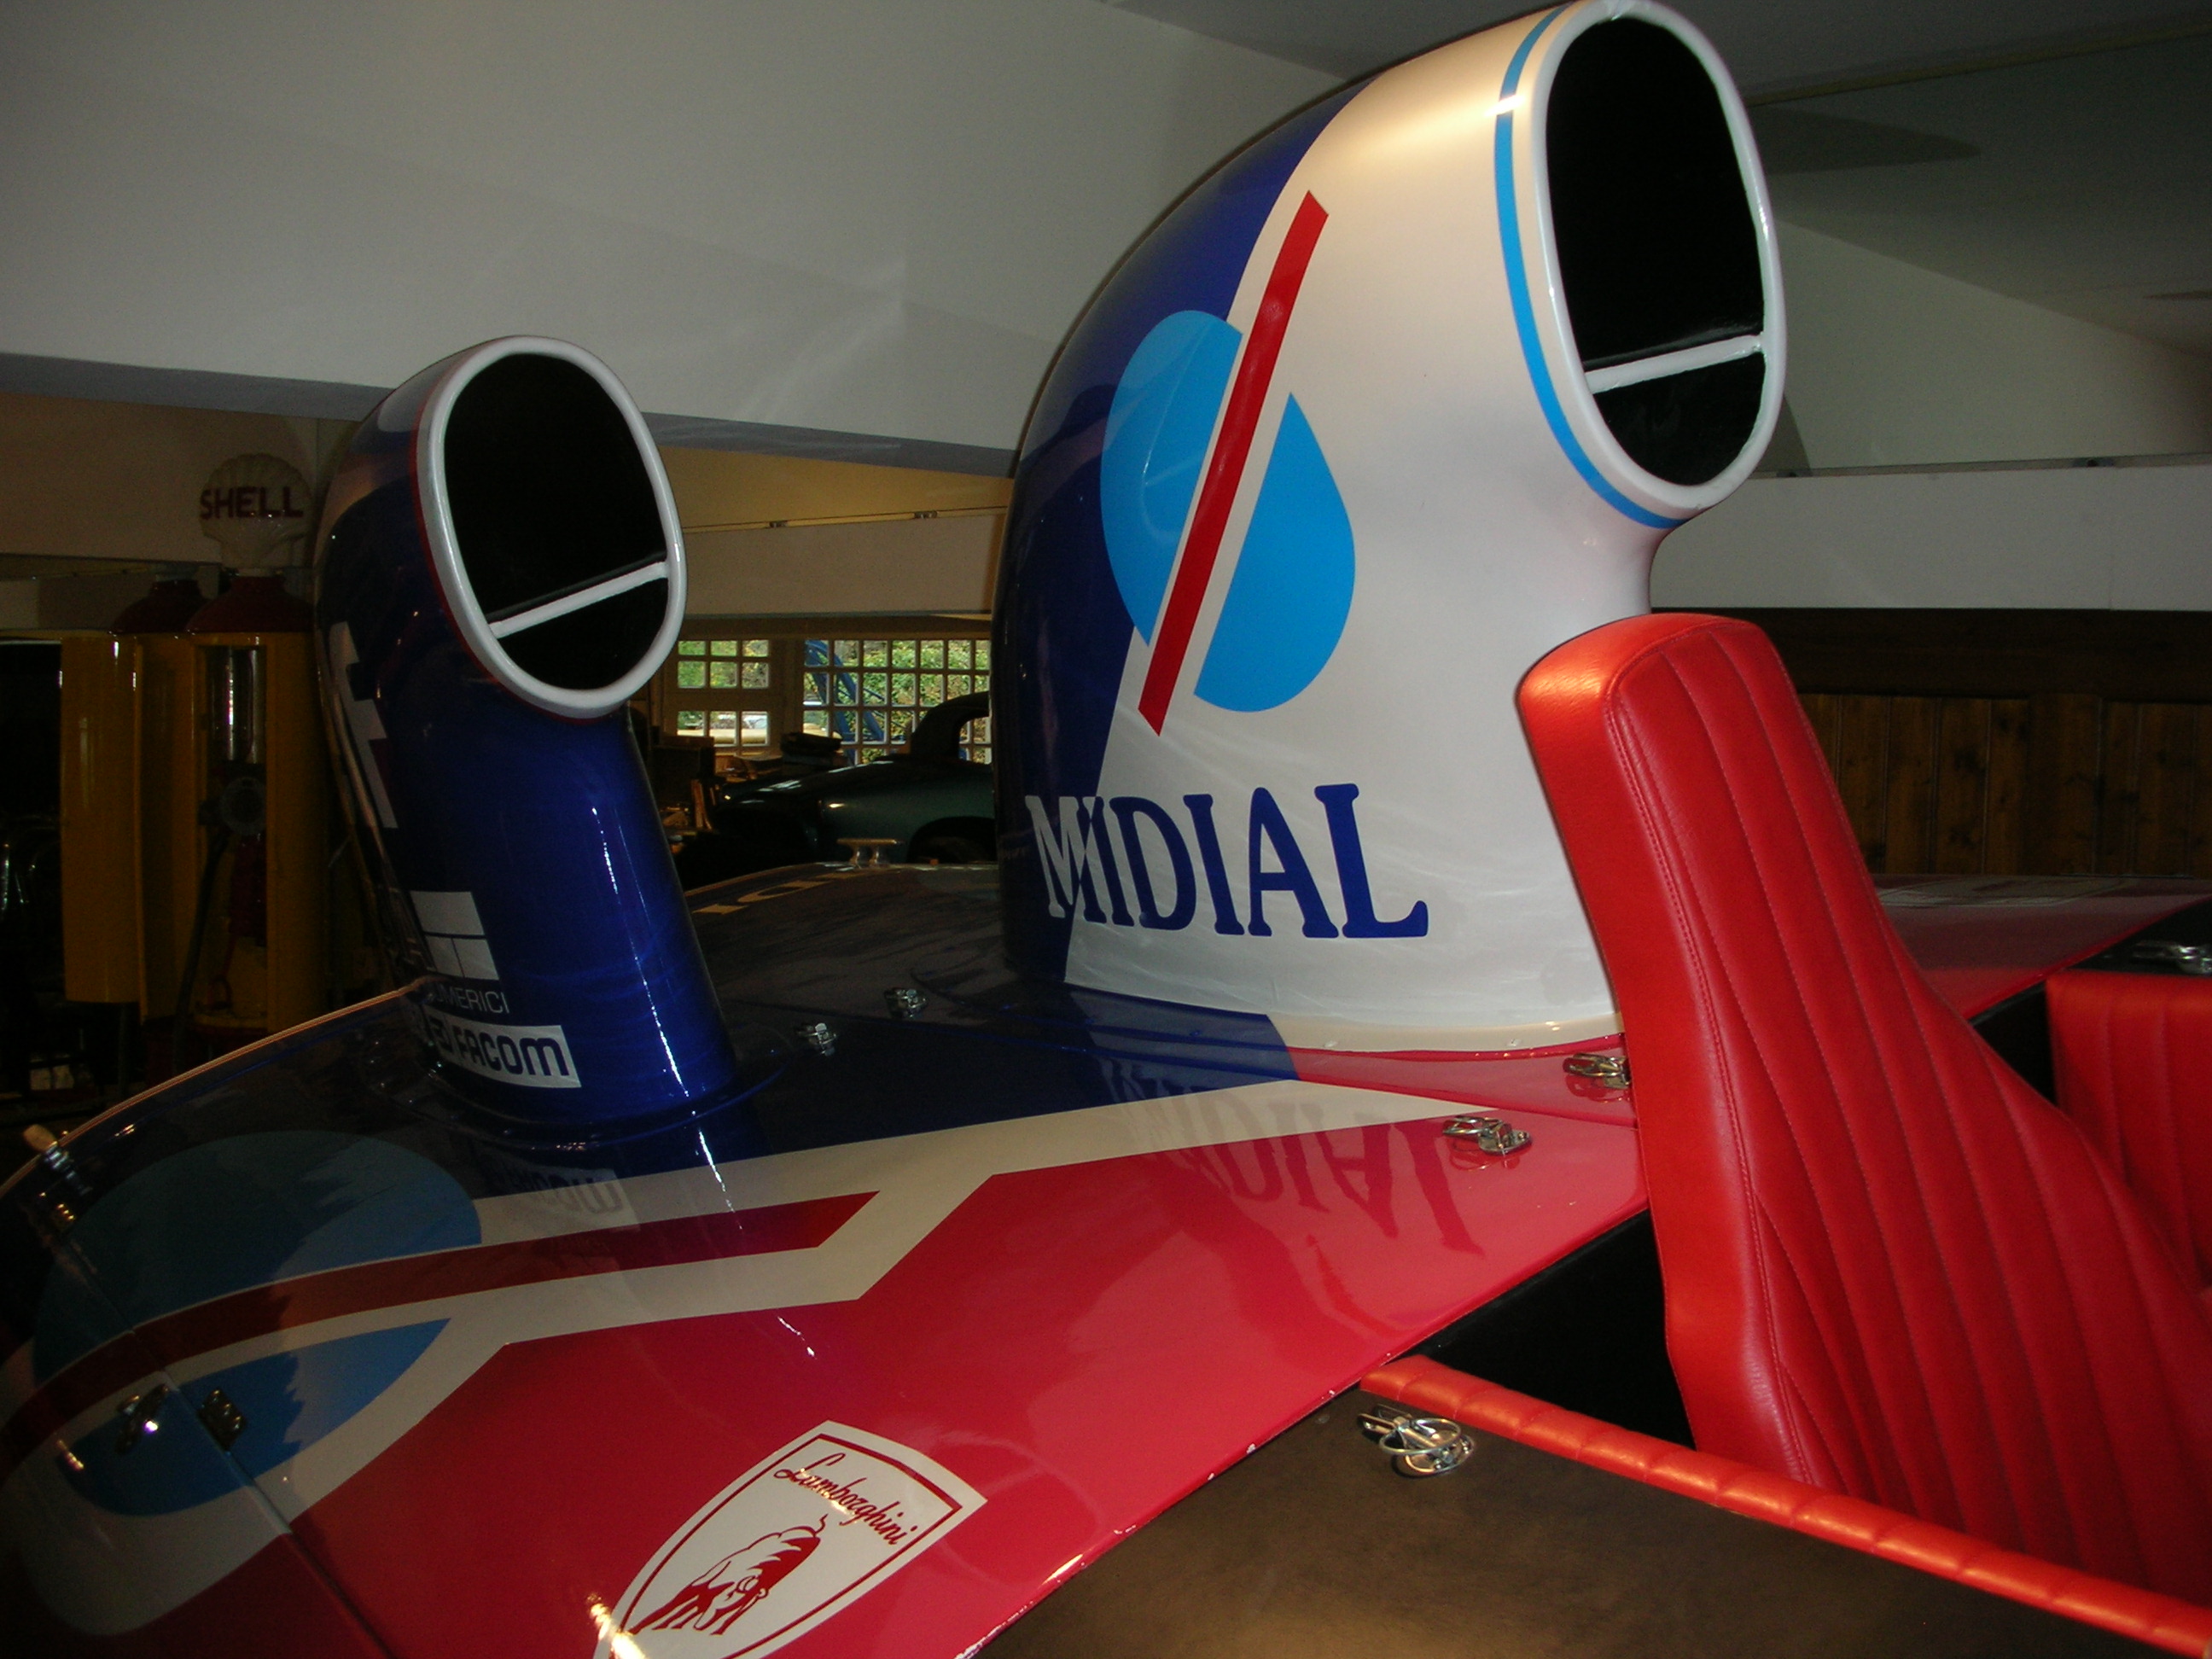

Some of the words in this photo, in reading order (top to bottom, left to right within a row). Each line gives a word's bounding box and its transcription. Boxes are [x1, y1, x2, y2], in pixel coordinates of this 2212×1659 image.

[200, 486, 303, 519] SHELL
[1025, 783, 1429, 939] MIDIAL
[774, 1452, 917, 1545] Lamborghini
